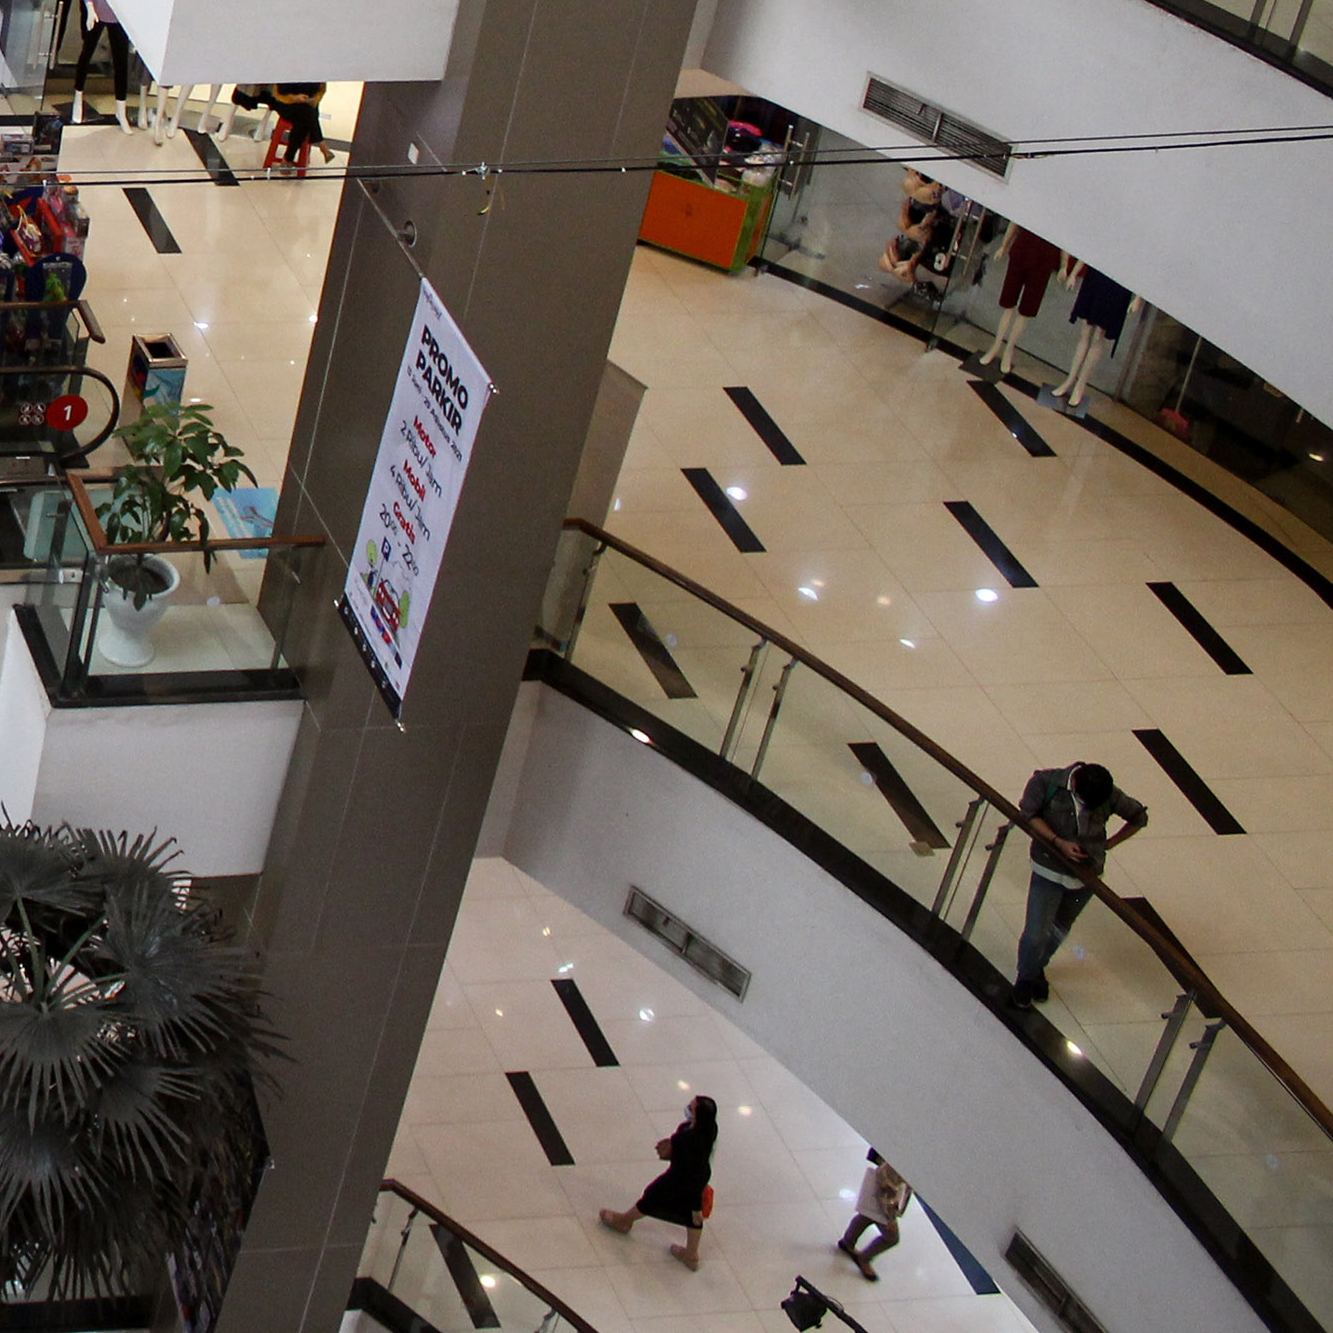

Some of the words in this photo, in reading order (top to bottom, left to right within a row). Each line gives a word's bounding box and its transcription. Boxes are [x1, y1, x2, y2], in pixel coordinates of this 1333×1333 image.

[421, 323, 469, 411] PROMO
[62, 404, 73, 421] 1
[415, 348, 463, 437] PARKIR
[399, 419, 407, 436] 2
[412, 414, 436, 459] Motor
[403, 459, 427, 502] Mobil
[393, 501, 416, 545] Gratis
